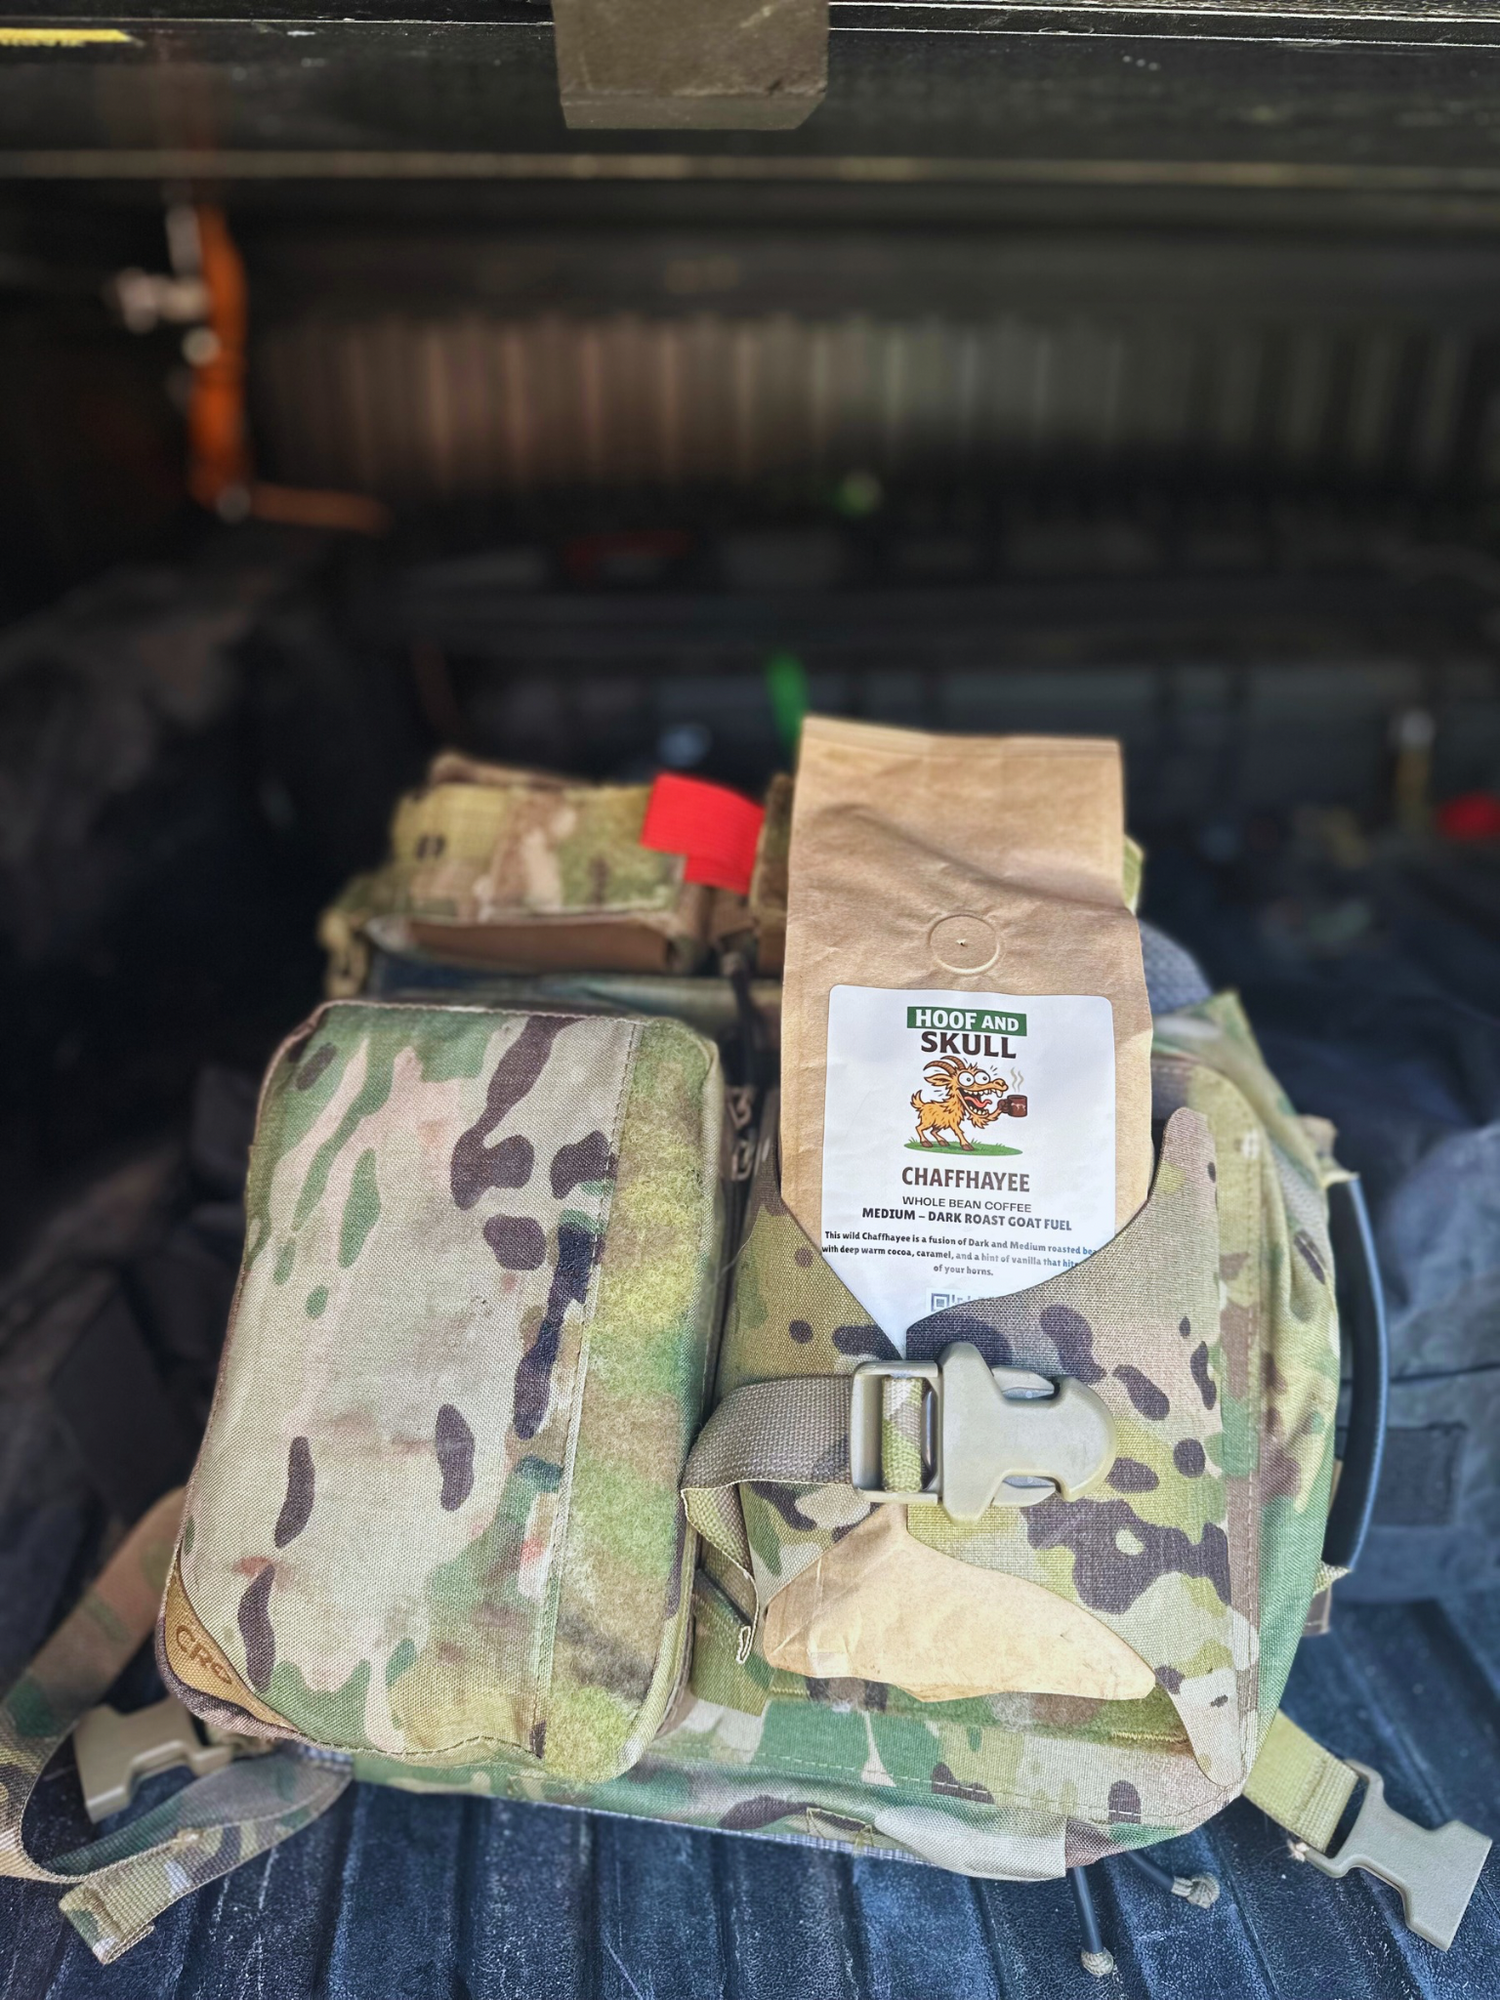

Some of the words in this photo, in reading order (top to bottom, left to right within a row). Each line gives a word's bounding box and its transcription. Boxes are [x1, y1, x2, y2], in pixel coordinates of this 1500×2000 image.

[915, 1009, 977, 1030] HOOF
[981, 1015, 1019, 1032] AND
[921, 1031, 1017, 1059] SKULL
[902, 1166, 1030, 1192] CHAFFHAYEE
[902, 1196, 946, 1207] WHOLE
[949, 1199, 981, 1210] BEAN
[984, 1201, 1032, 1213] COFFEE
[862, 1207, 916, 1221] MEDIUM
[928, 1211, 962, 1224] DARK
[964, 1213, 1005, 1226] ROAST
[1008, 1216, 1042, 1229] GOAT
[1044, 1218, 1072, 1231] FUEL
[825, 1231, 841, 1240] This
[842, 1231, 860, 1240] wild
[862, 1232, 910, 1243] Chaffhayee
[912, 1234, 919, 1243] is
[928, 1235, 956, 1245] fusion
[958, 1238, 967, 1246] of
[968, 1238, 989, 1248] Dark
[991, 1241, 1008, 1249] and
[1010, 1241, 1046, 1252] Medium
[1048, 1245, 1081, 1255] roasted
[821, 1244, 839, 1253] with
[840, 1245, 860, 1255] deep
[887, 1248, 915, 1257] cocoa,
[916, 1250, 955, 1260] caramel,
[956, 1252, 972, 1260] and
[981, 1253, 999, 1262] hint
[1000, 1255, 1010, 1263] of
[1011, 1256, 1041, 1266] vanilla
[1043, 1258, 1061, 1267] that
[933, 1264, 943, 1272] of
[944, 1265, 965, 1274] your
[966, 1266, 994, 1276] horns.
